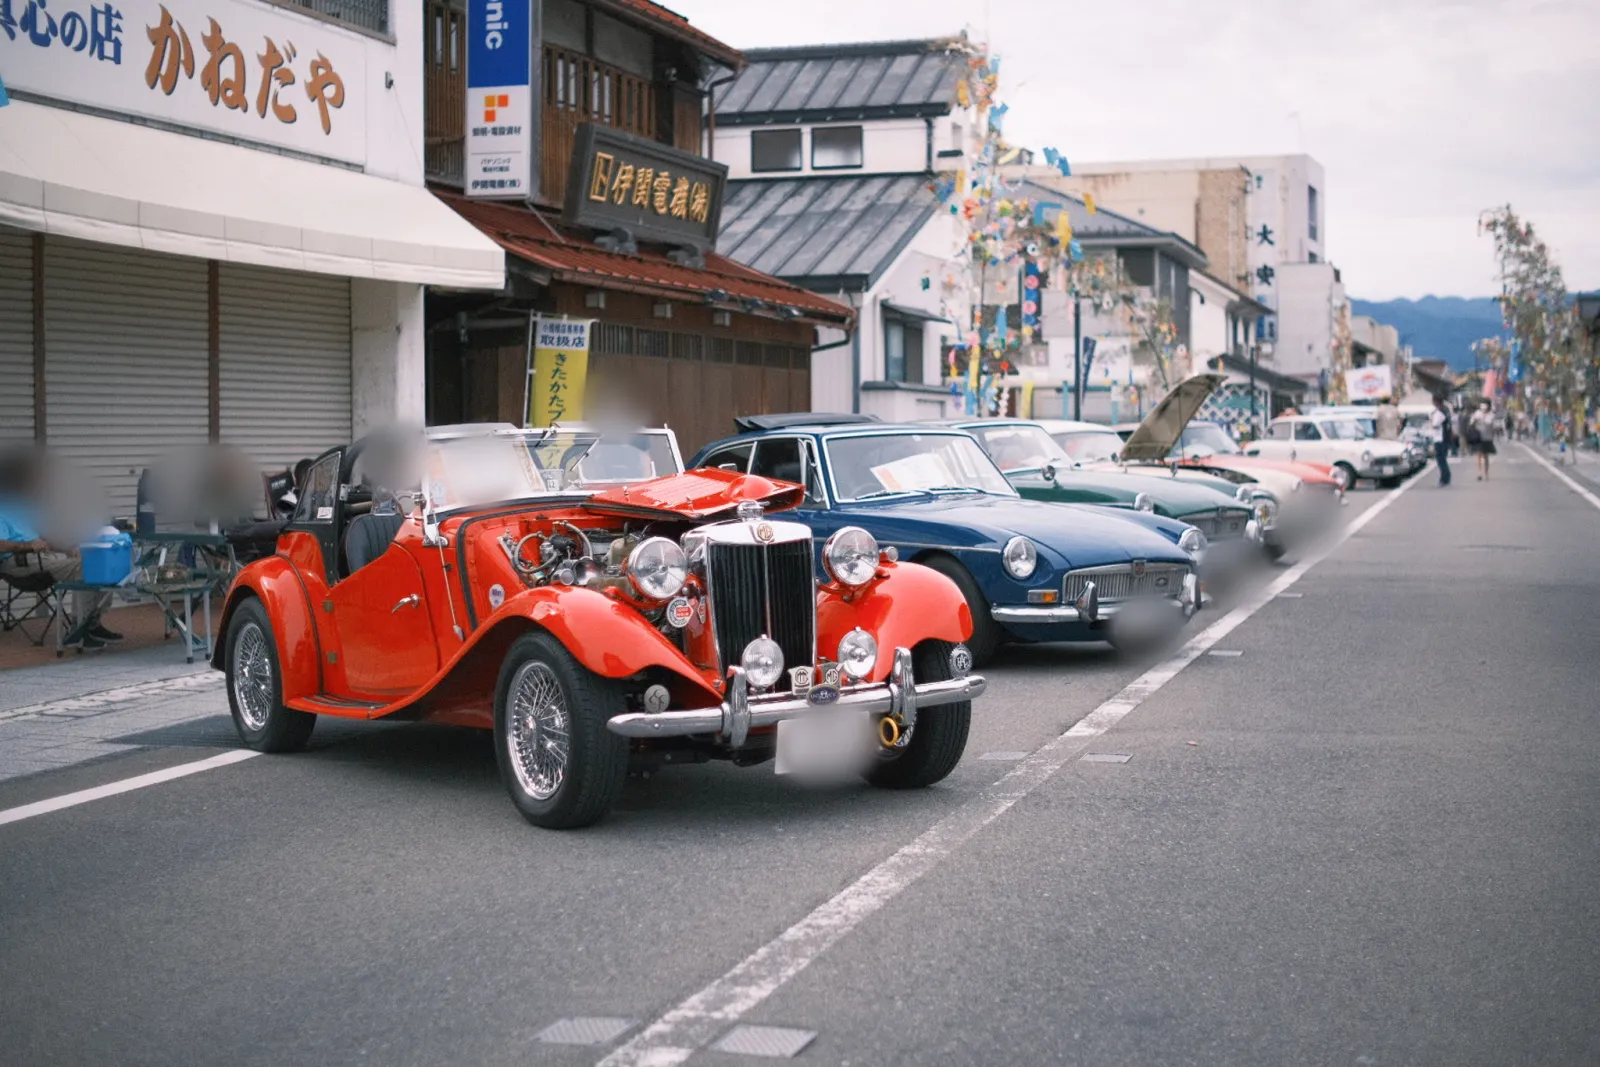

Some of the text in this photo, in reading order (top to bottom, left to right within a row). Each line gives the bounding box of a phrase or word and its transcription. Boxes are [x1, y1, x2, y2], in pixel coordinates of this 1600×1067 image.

[485, 0, 509, 50] nic
[145, 3, 345, 135] かねだや
[540, 334, 586, 347] 取扱店
[758, 524, 773, 540] MG
[826, 670, 838, 683] MG
